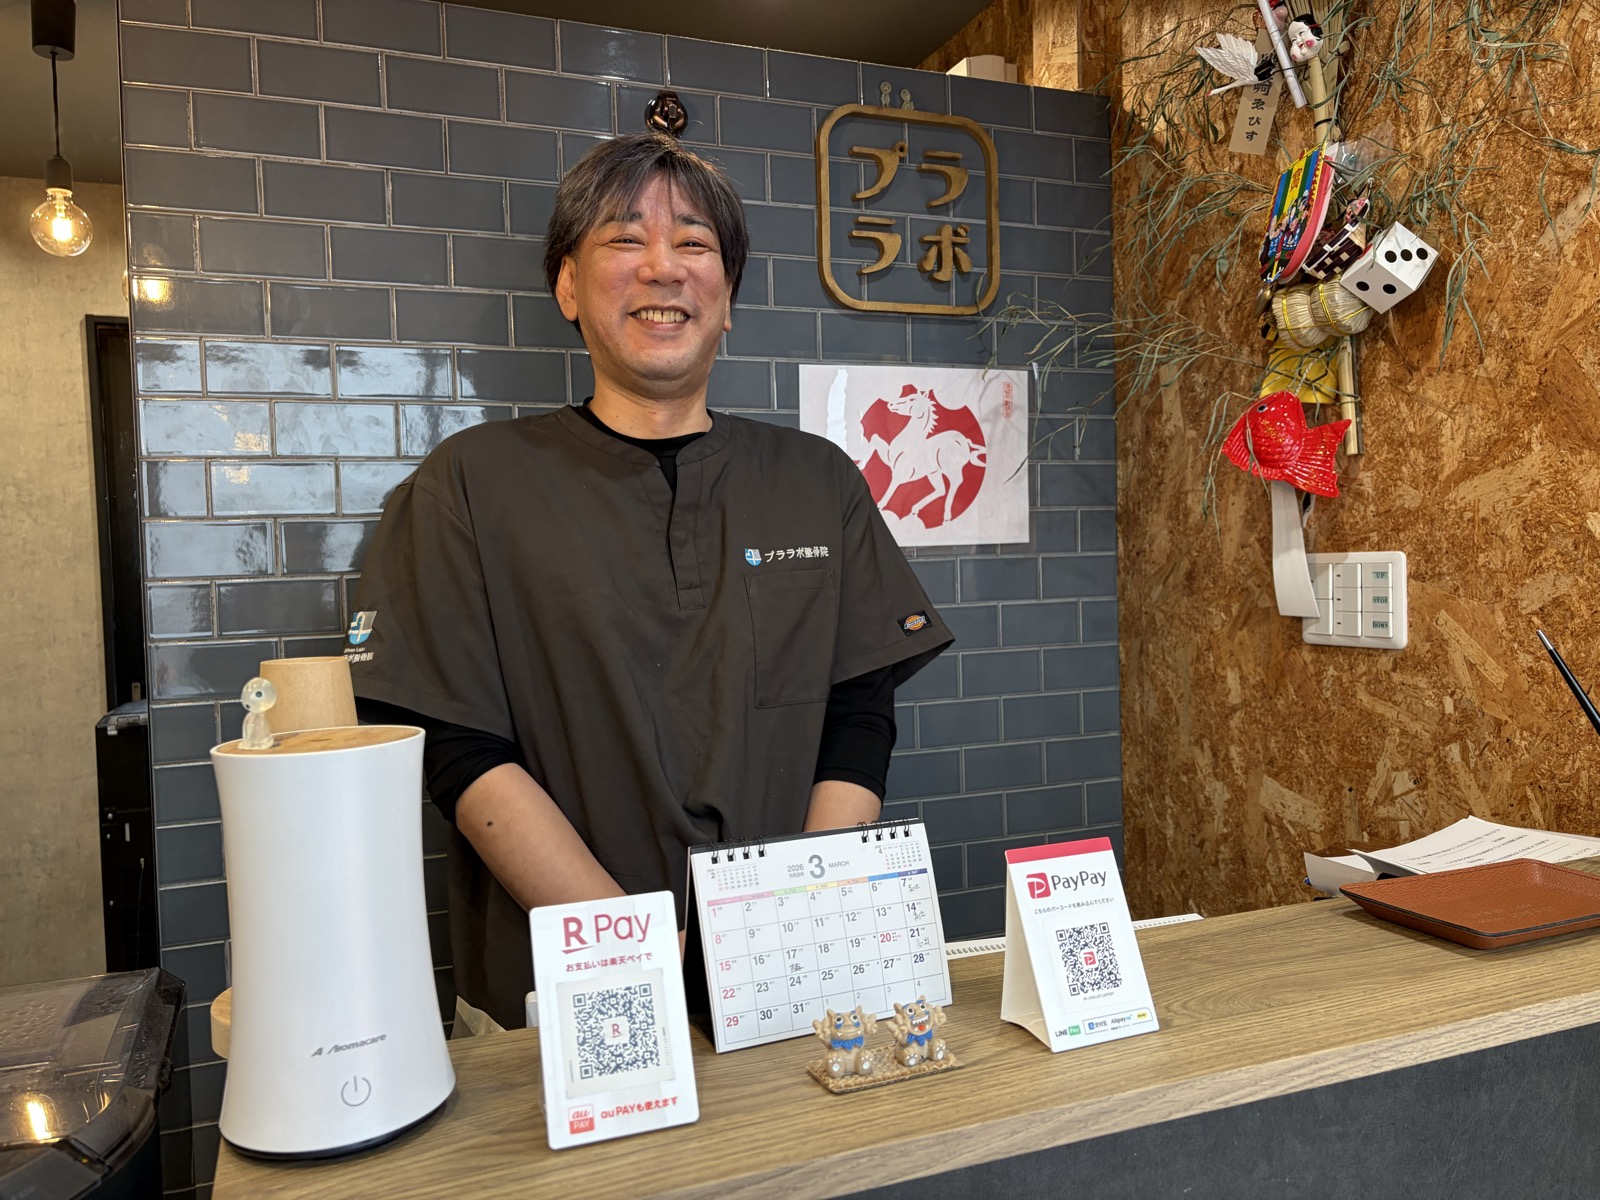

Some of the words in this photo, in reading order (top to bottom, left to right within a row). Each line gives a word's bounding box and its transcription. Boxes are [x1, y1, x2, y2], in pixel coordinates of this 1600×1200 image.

[786, 864, 804, 872] 2026
[808, 854, 826, 879] 3
[828, 860, 850, 868] MARCH
[1050, 870, 1107, 891] PayPay
[712, 907, 717, 917] 1
[745, 902, 751, 912] 2
[778, 897, 784, 907] 3
[810, 892, 816, 901] 4
[841, 887, 847, 896] 5
[872, 882, 877, 891] 6
[901, 878, 906, 888] 7
[563, 916, 589, 947] R
[594, 913, 651, 943] Pay
[715, 934, 721, 944] 8
[749, 929, 755, 938] 9
[782, 923, 793, 933] 10
[814, 917, 823, 927] 11
[846, 912, 856, 922] 12
[876, 907, 887, 917] 13
[906, 902, 916, 912] 14
[565, 952, 653, 972] お支払いは楽天ペイで
[719, 961, 731, 971] 15
[753, 955, 764, 965] 16
[786, 950, 797, 959] 17
[818, 944, 829, 954] 18
[850, 938, 860, 948] 19
[880, 933, 891, 943] 20
[909, 928, 920, 938] 21
[722, 989, 735, 999] 22
[757, 982, 769, 993] 23
[790, 976, 801, 986] 24
[822, 970, 833, 980] 25
[853, 965, 864, 975] 26
[884, 959, 894, 969] 27
[913, 953, 924, 963] 28
[726, 1016, 738, 1027] 29
[760, 1010, 772, 1020] 30
[793, 1003, 804, 1014] 31
[1055, 1029, 1068, 1038] LINE
